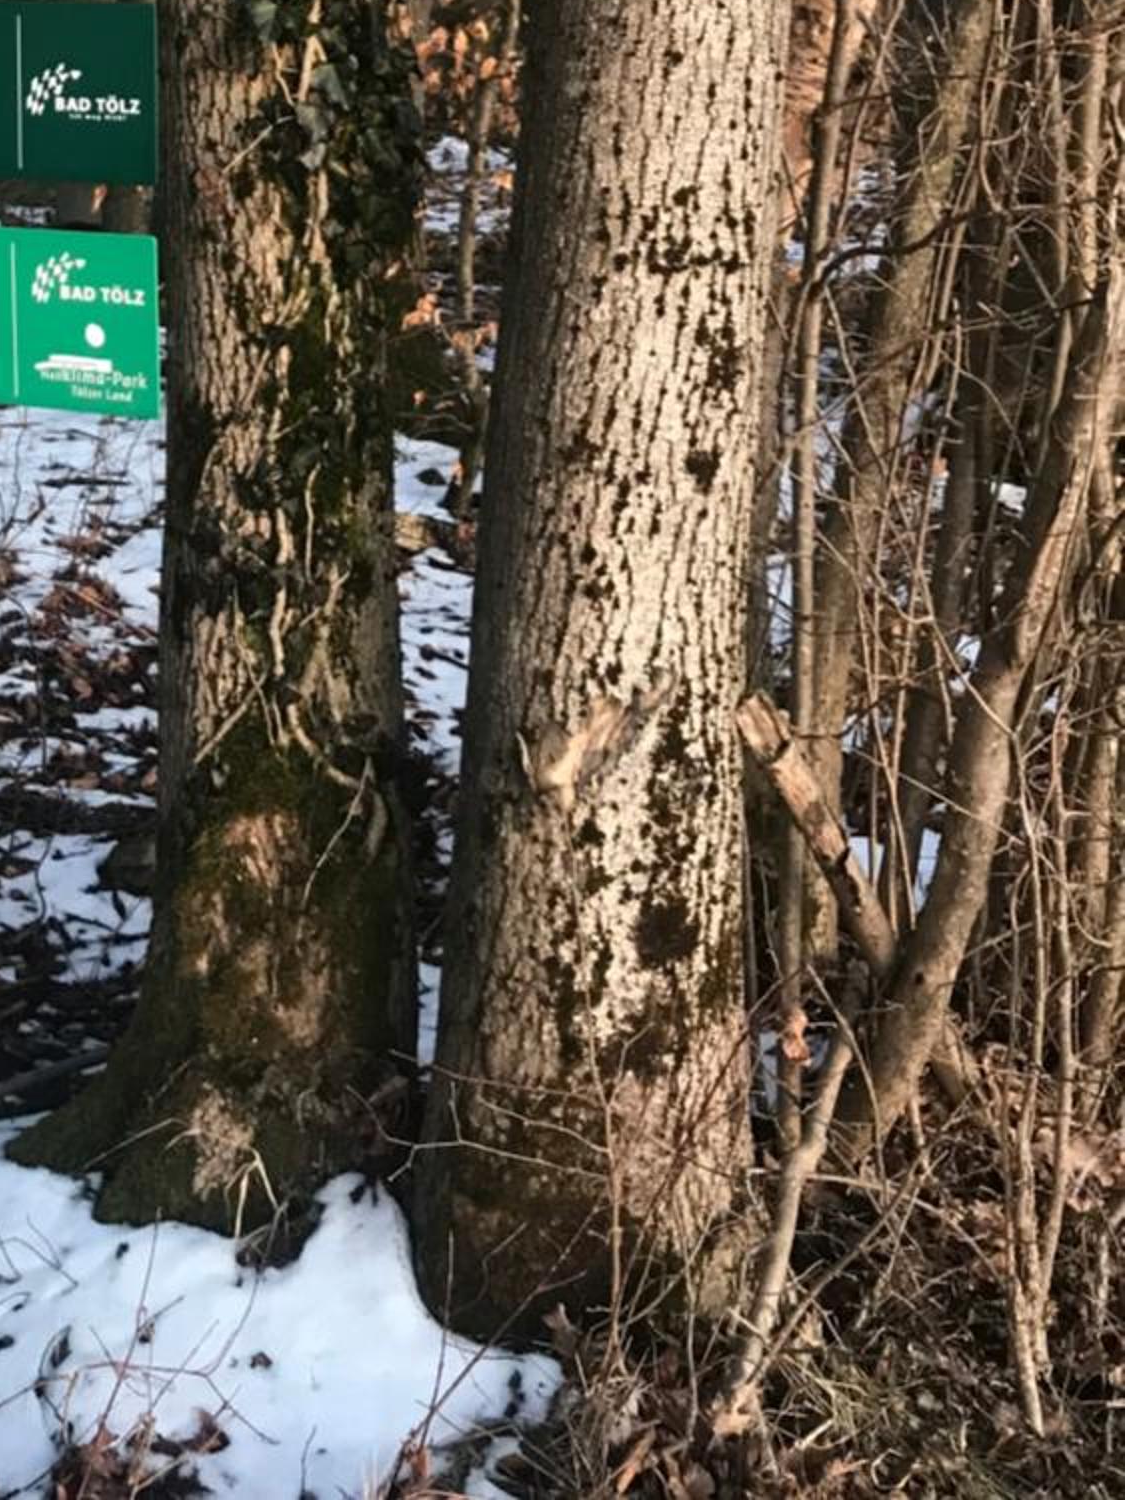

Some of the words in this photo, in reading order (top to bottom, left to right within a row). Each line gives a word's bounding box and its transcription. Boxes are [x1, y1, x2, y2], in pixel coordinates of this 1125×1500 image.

[54, 96, 92, 113] BAD
[95, 94, 141, 116] TÖLZ
[59, 285, 96, 301] BAD
[99, 285, 145, 307] TÖLZ
